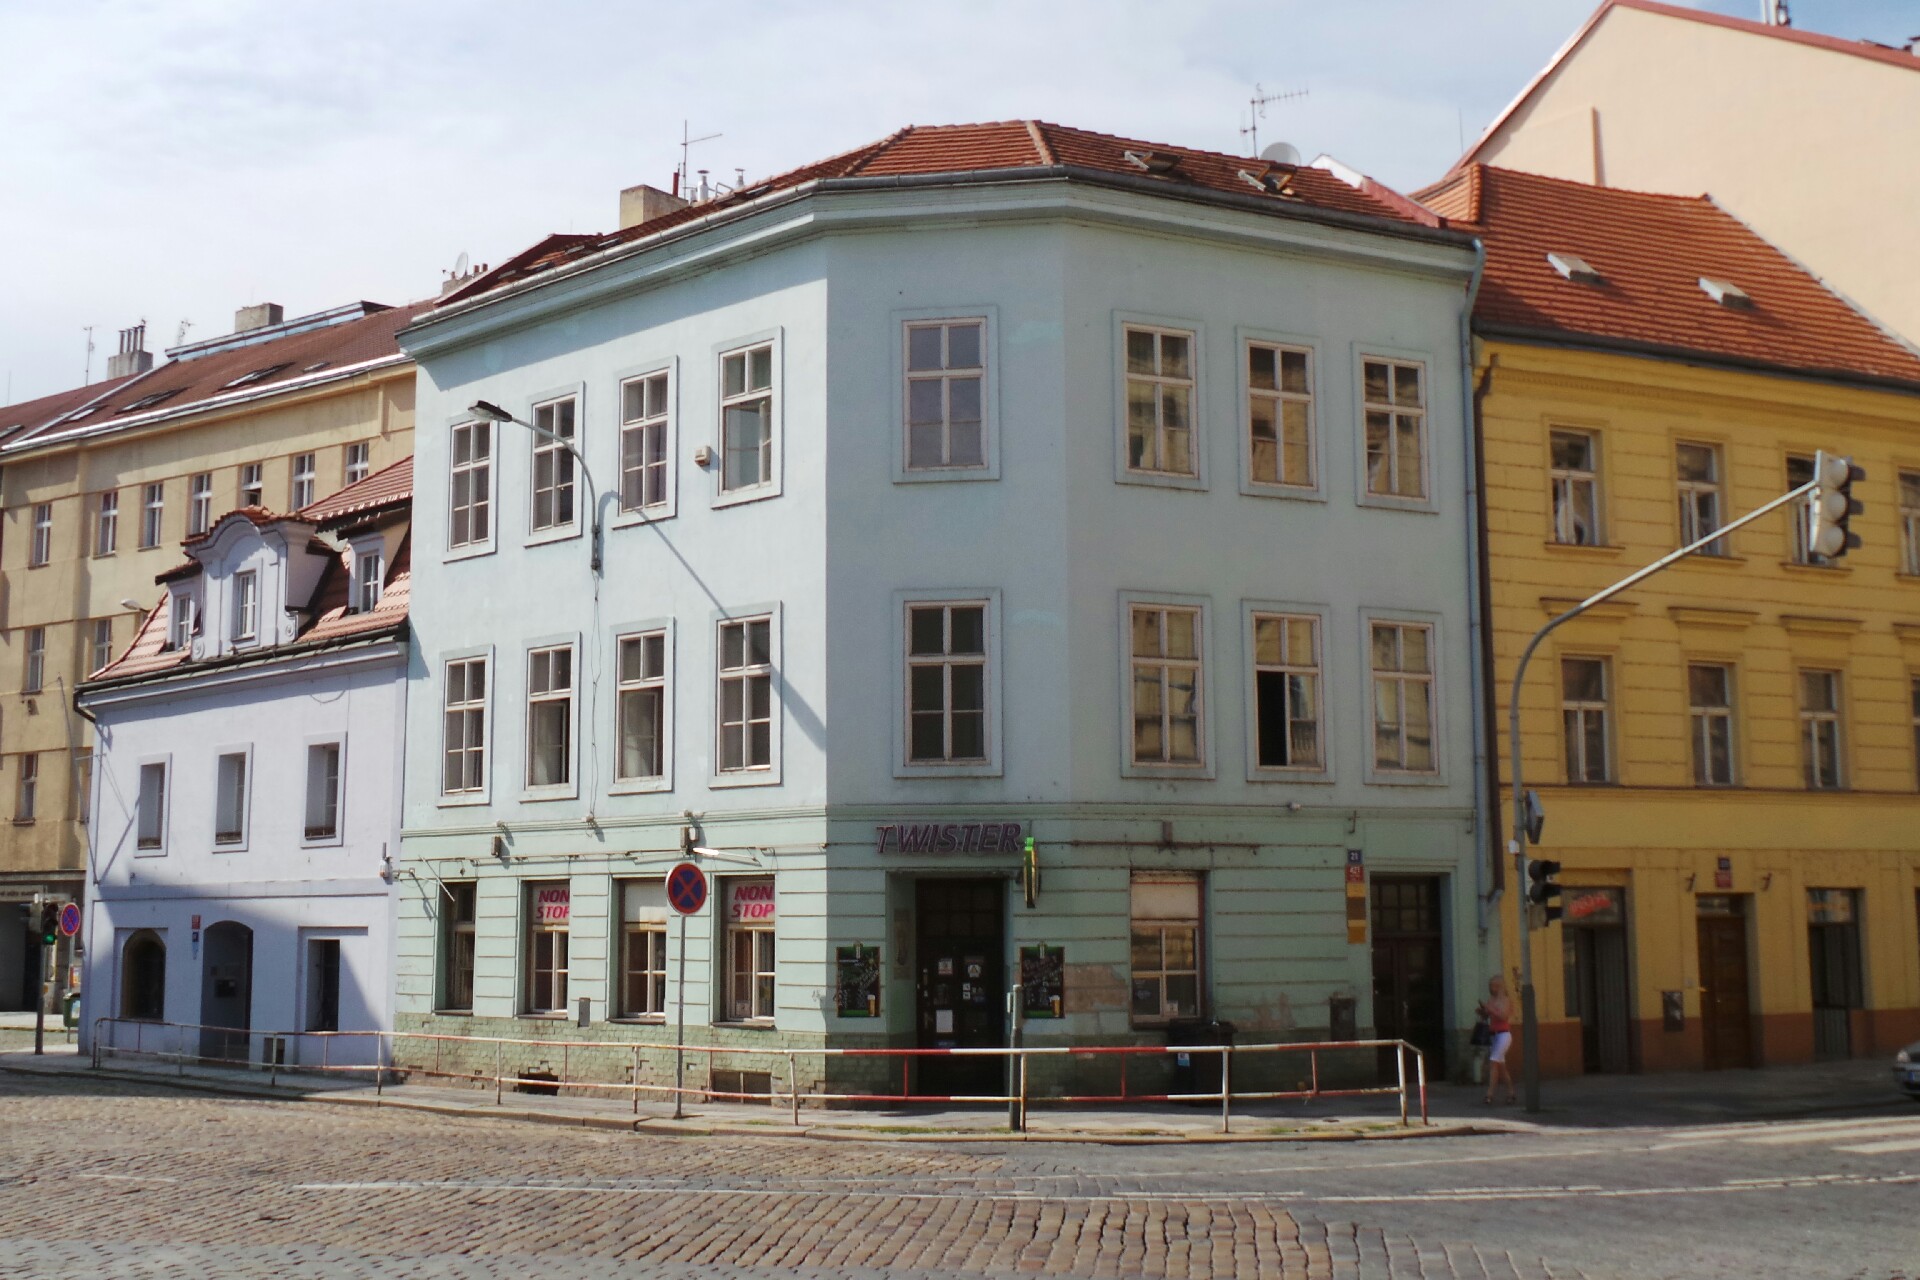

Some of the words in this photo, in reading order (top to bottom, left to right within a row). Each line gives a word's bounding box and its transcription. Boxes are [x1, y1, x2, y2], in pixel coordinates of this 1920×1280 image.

[876, 823, 1022, 853] TWISTER
[538, 889, 569, 902] NON
[735, 885, 773, 900] NON
[731, 903, 775, 918] STOP
